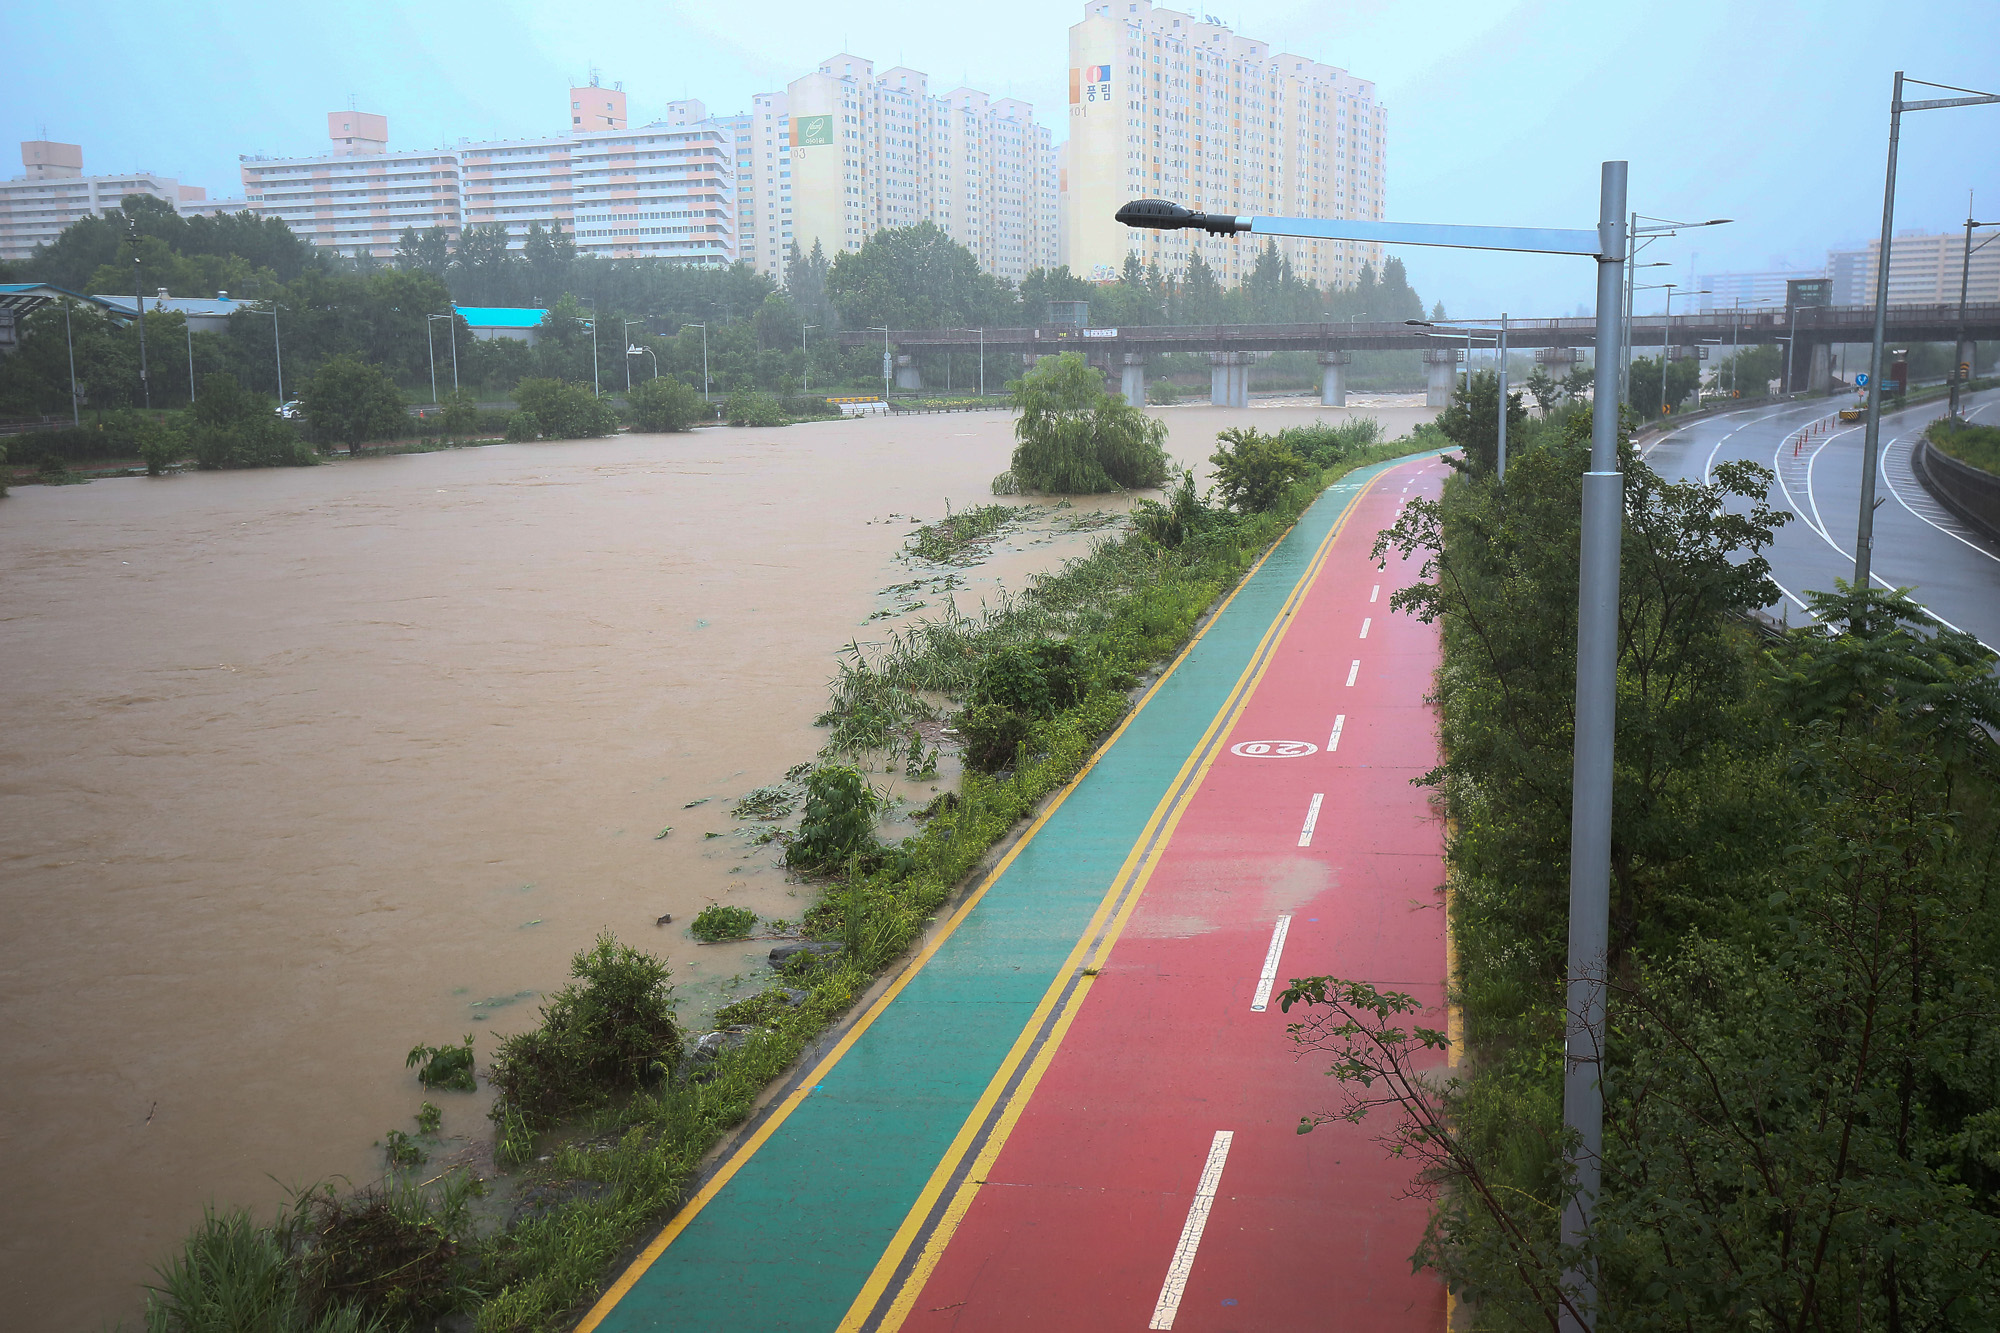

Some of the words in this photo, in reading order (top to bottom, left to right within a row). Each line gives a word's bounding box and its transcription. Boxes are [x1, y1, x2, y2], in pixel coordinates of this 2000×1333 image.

[1087, 84, 1110, 102] 풍림
[1070, 105, 1087, 117] 101
[790, 147, 806, 159] 103
[1245, 743, 1305, 755] 20
